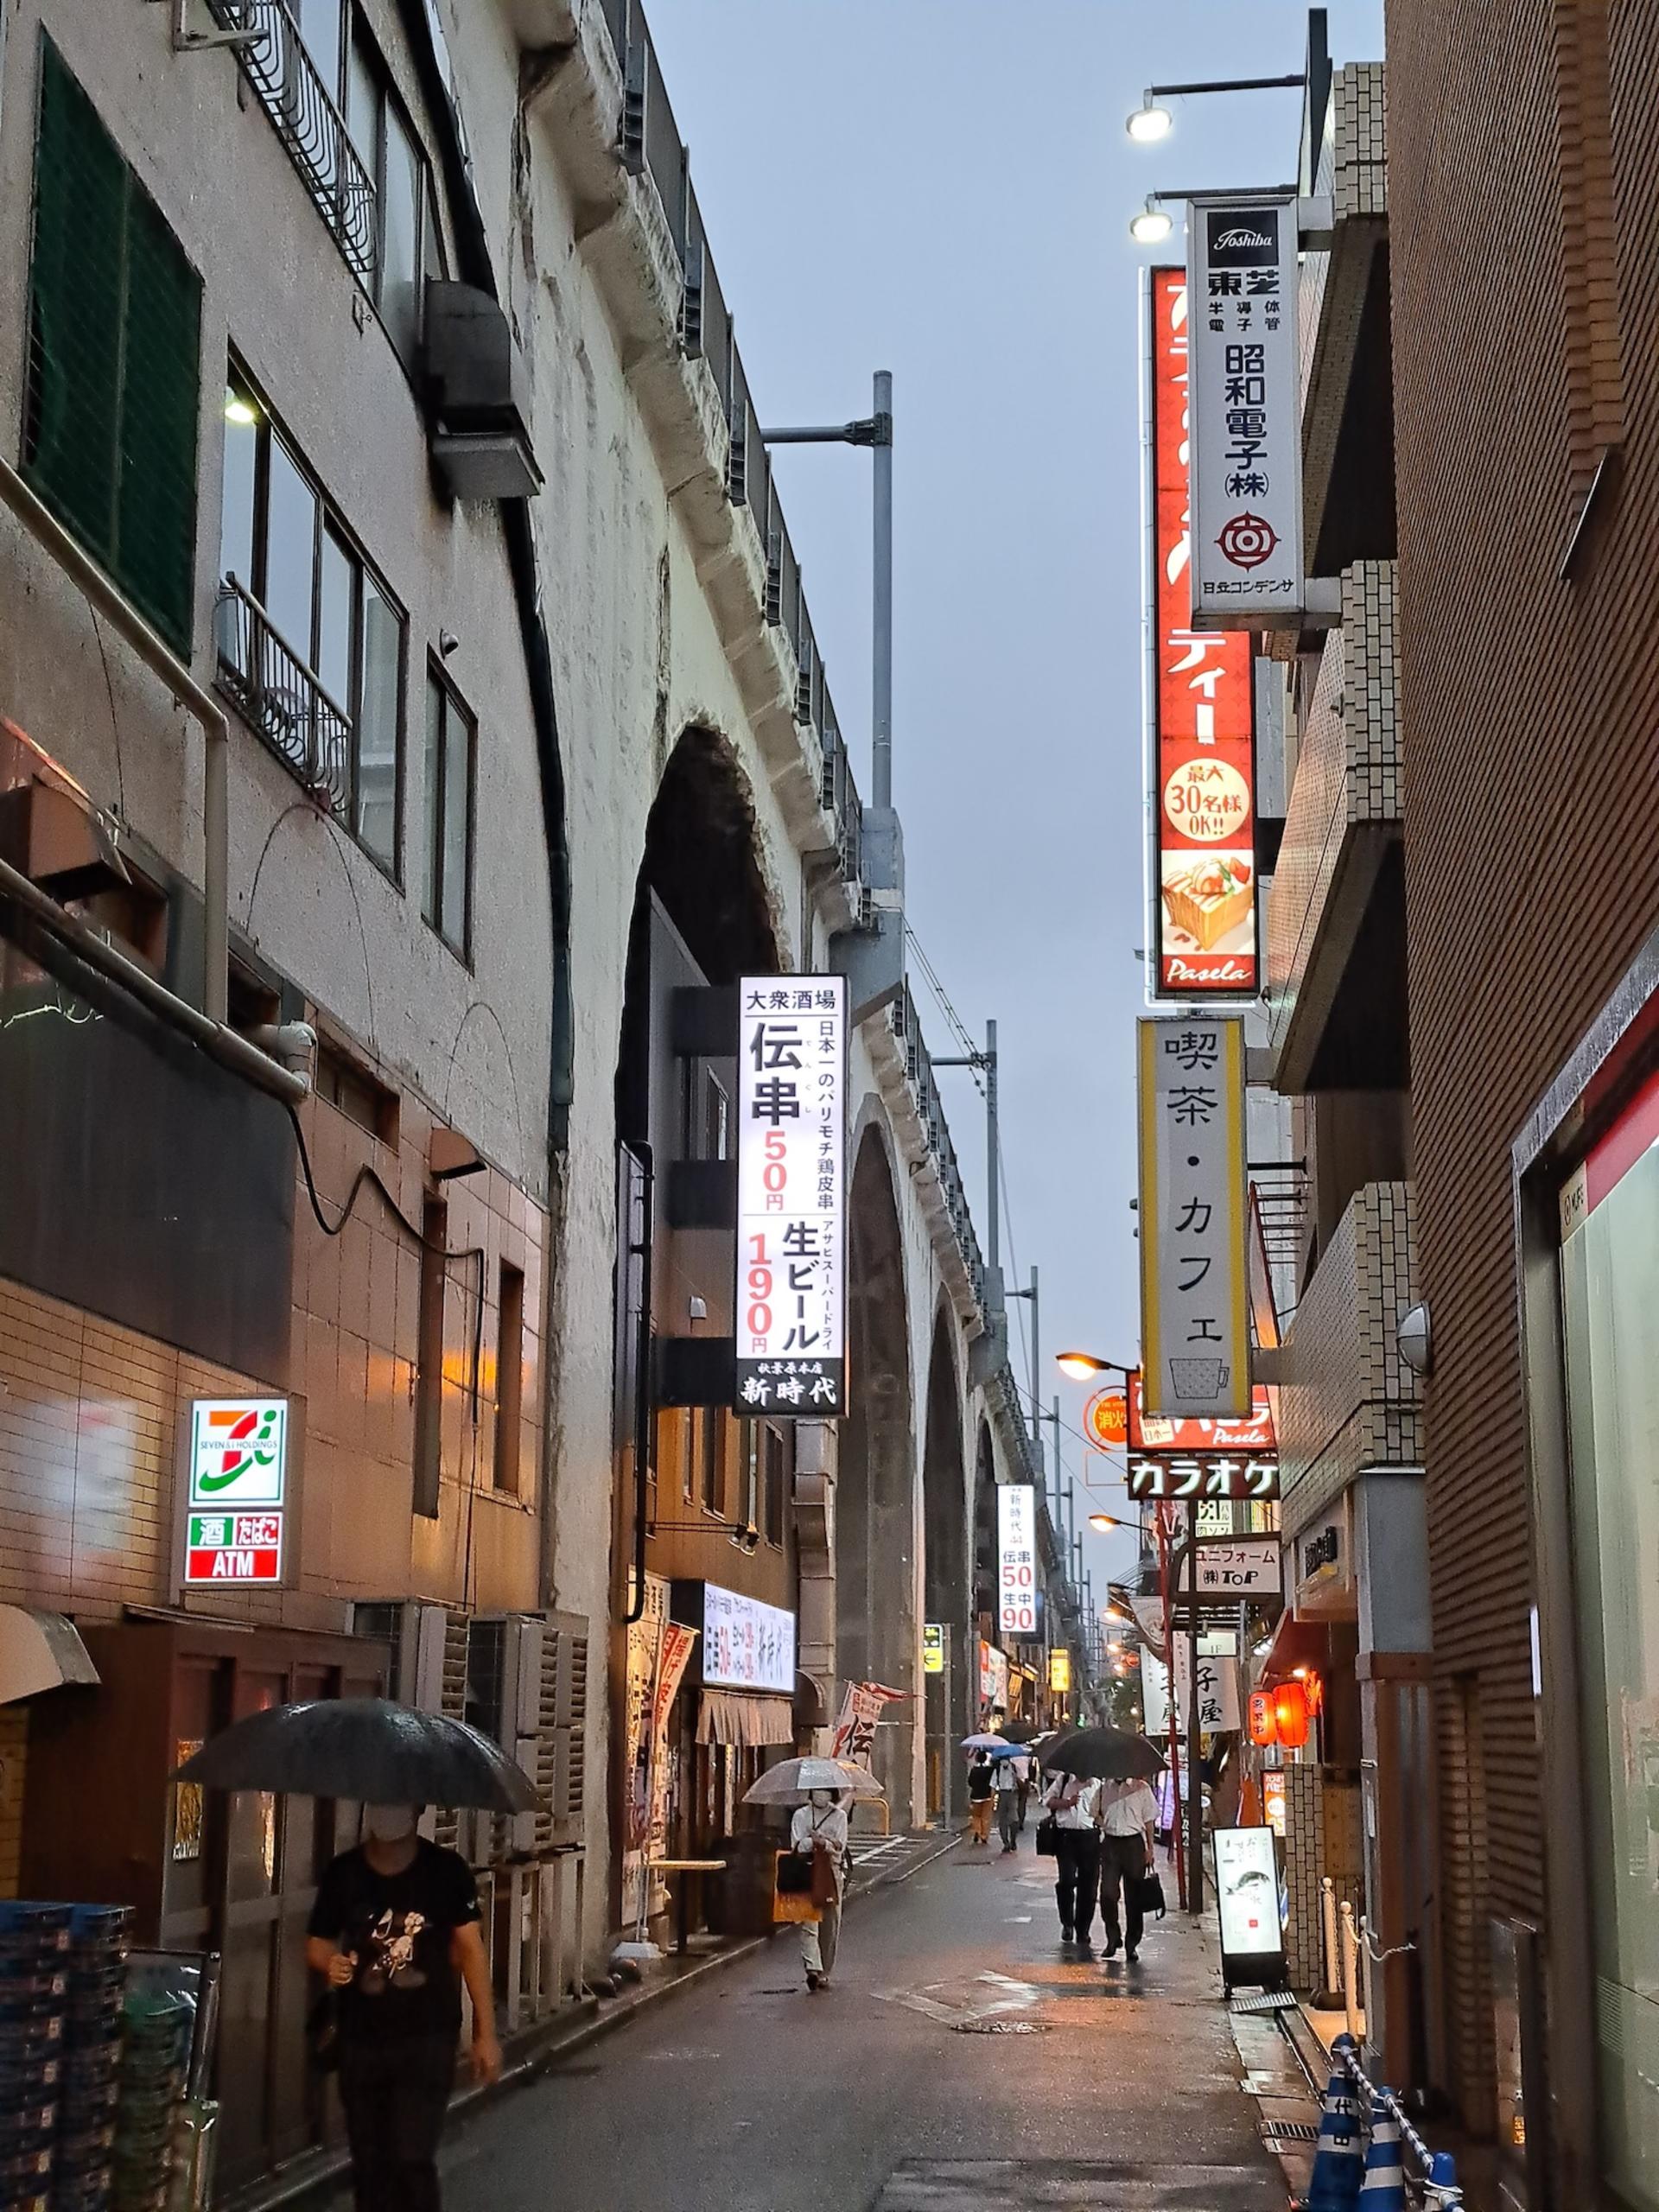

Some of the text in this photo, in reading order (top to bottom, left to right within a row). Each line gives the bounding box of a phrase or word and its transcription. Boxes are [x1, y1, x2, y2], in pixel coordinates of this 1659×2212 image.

[1213, 228, 1273, 250] Toshiba
[1208, 270, 1280, 296] 東芝
[1209, 301, 1281, 315] 半導体
[1209, 318, 1281, 332] 電子管
[1203, 580, 1294, 596] 日立コンデンサ
[1187, 766, 1224, 782] 最大
[1171, 785, 1243, 814] 30名様
[1190, 816, 1224, 836] OK!!
[1166, 958, 1251, 982] Pasela
[746, 990, 836, 1010] 大衆酒場
[749, 1022, 804, 1126] 伝串
[763, 1131, 787, 1211] 50円
[747, 1233, 772, 1353] 190円
[782, 1221, 820, 1351] 生ビール
[741, 1376, 837, 1407] 新時代
[1098, 1410, 1127, 1429] 消火
[1212, 1428, 1269, 1445] Pasela
[1131, 1459, 1279, 1496] カラオケ
[200, 1517, 278, 1545] 酒 たばこ
[213, 1551, 254, 1577] ATM
[1196, 1549, 1275, 1564] ユニフォーム
[1003, 1566, 1032, 1587] 50
[1003, 1592, 1031, 1605] 生中
[1002, 1608, 1032, 1629] 90
[1196, 1657, 1223, 1725] 子屋
